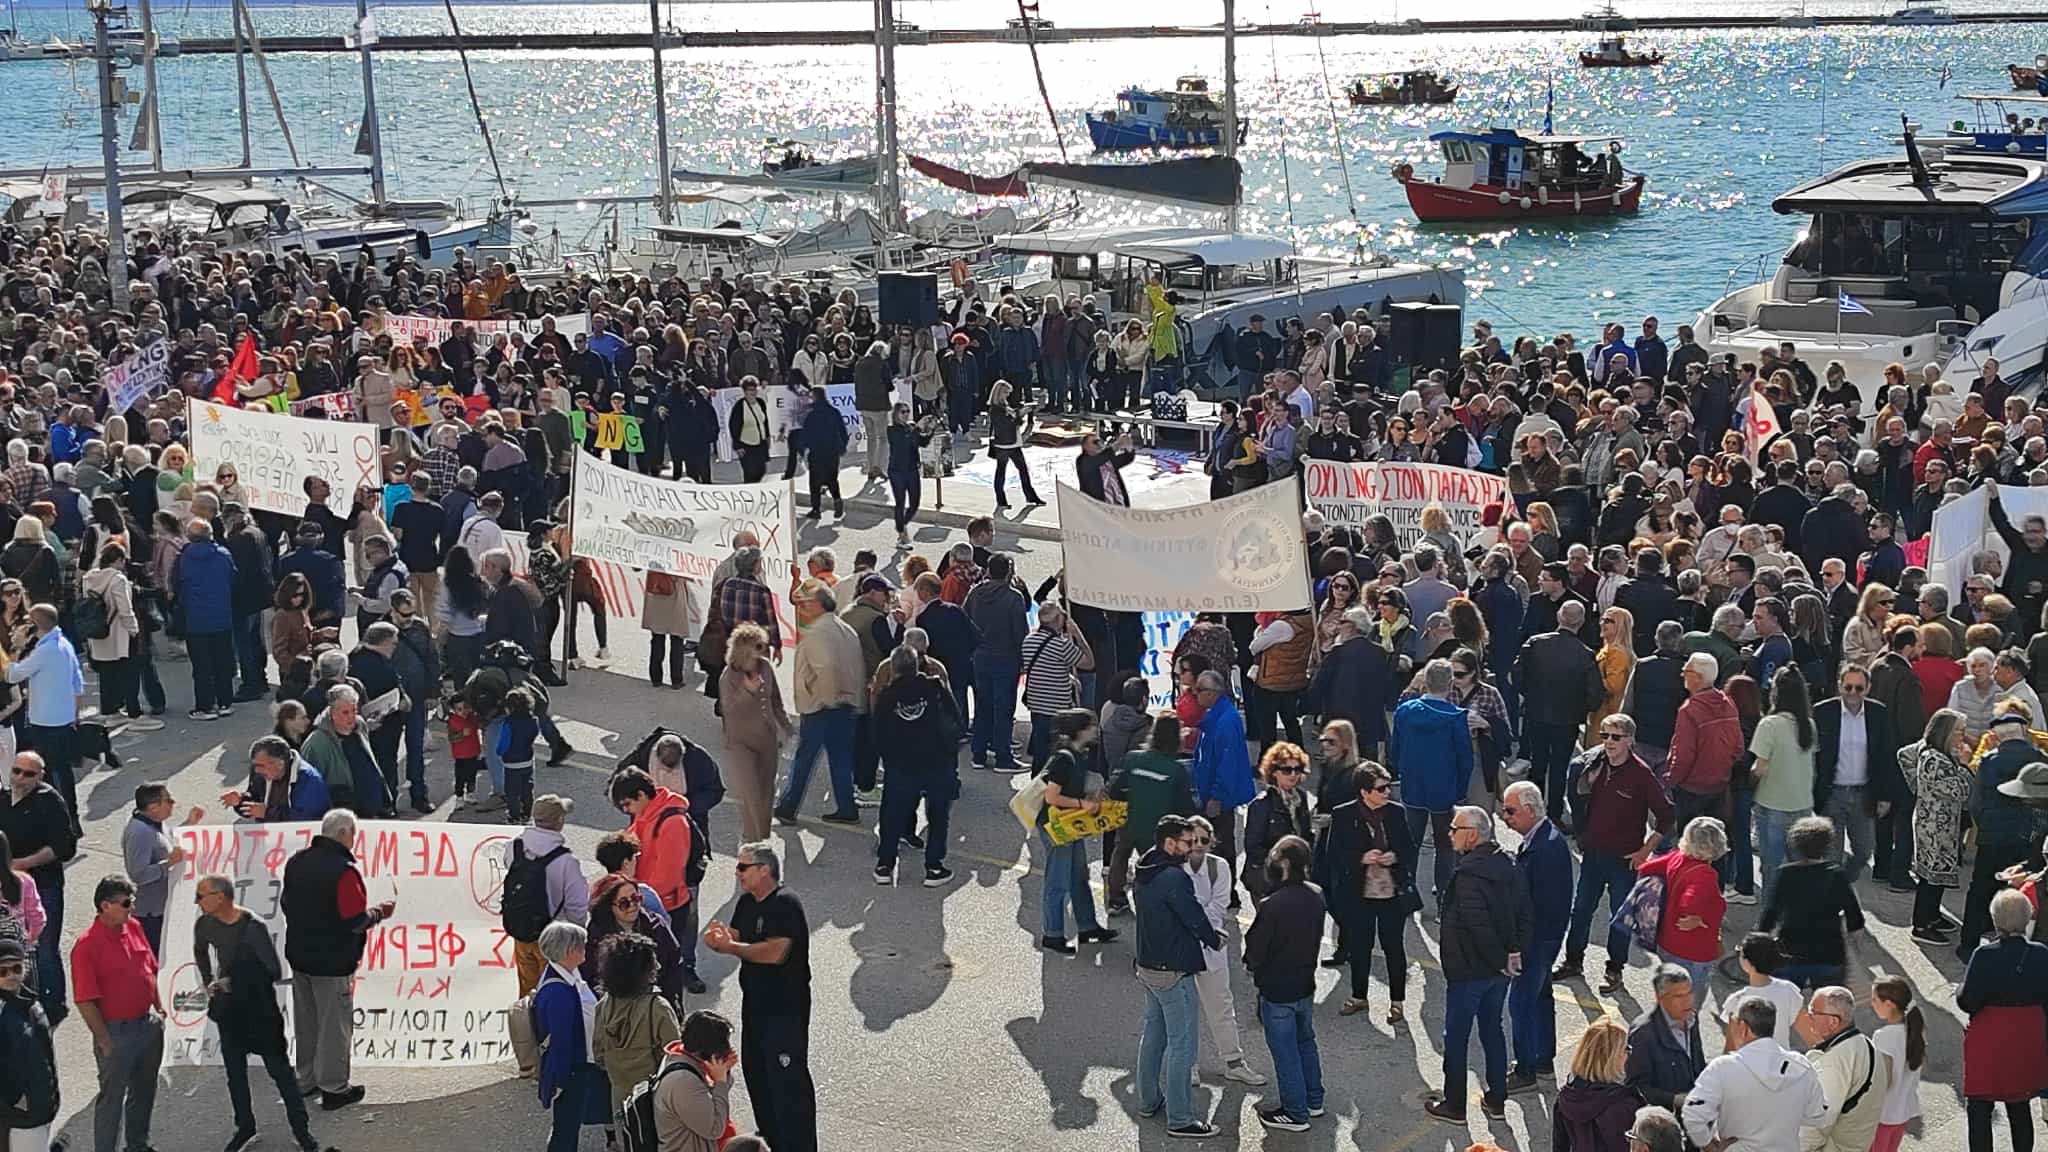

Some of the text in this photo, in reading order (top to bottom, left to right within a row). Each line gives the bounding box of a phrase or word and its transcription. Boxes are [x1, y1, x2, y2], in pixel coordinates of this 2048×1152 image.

[1308, 464, 1505, 505] ΟΧΙ LNG ΣΤΟΝ ΠΑΓΑΣΗΤ
